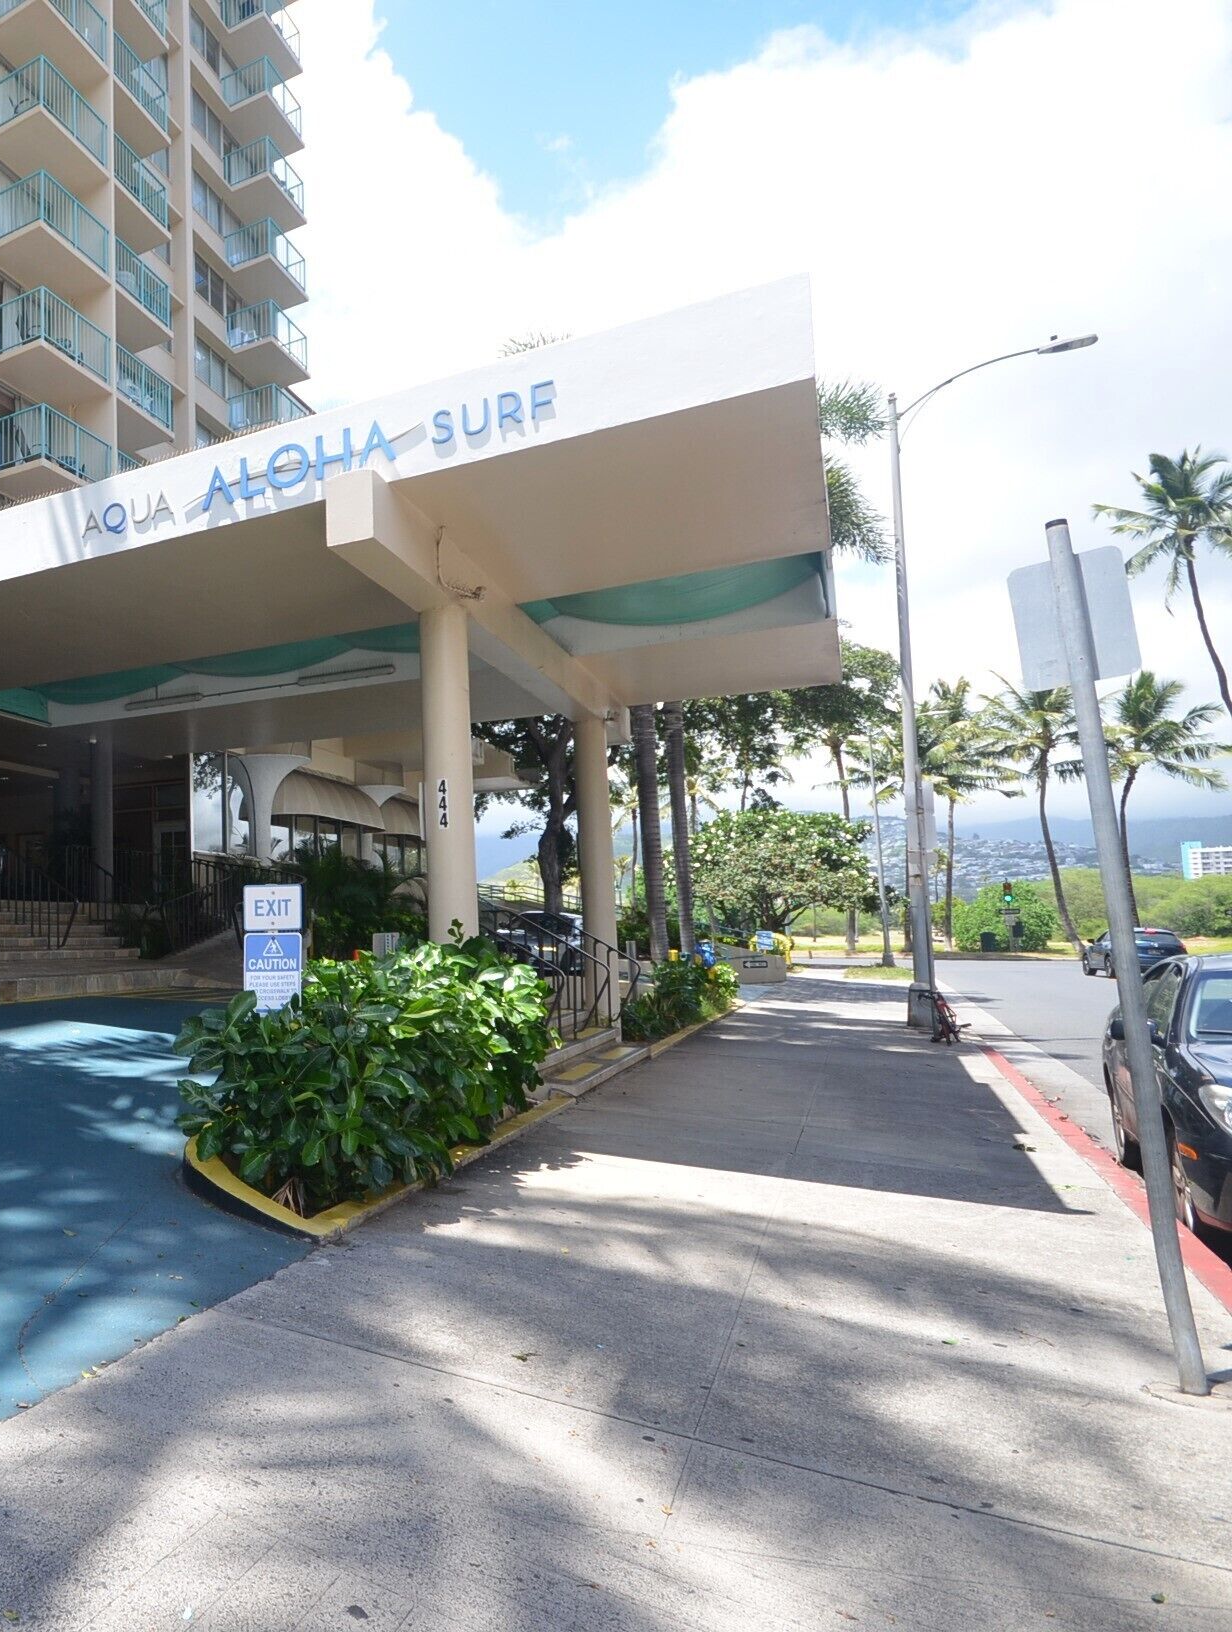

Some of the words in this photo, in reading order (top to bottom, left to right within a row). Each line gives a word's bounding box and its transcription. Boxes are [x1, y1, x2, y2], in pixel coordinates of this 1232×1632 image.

[82, 489, 176, 538] AQUA
[202, 419, 396, 511] ALOHA
[432, 379, 554, 444] SURF
[438, 779, 448, 828] 444
[254, 899, 291, 916] EXIT
[249, 958, 297, 970] CAUTION
